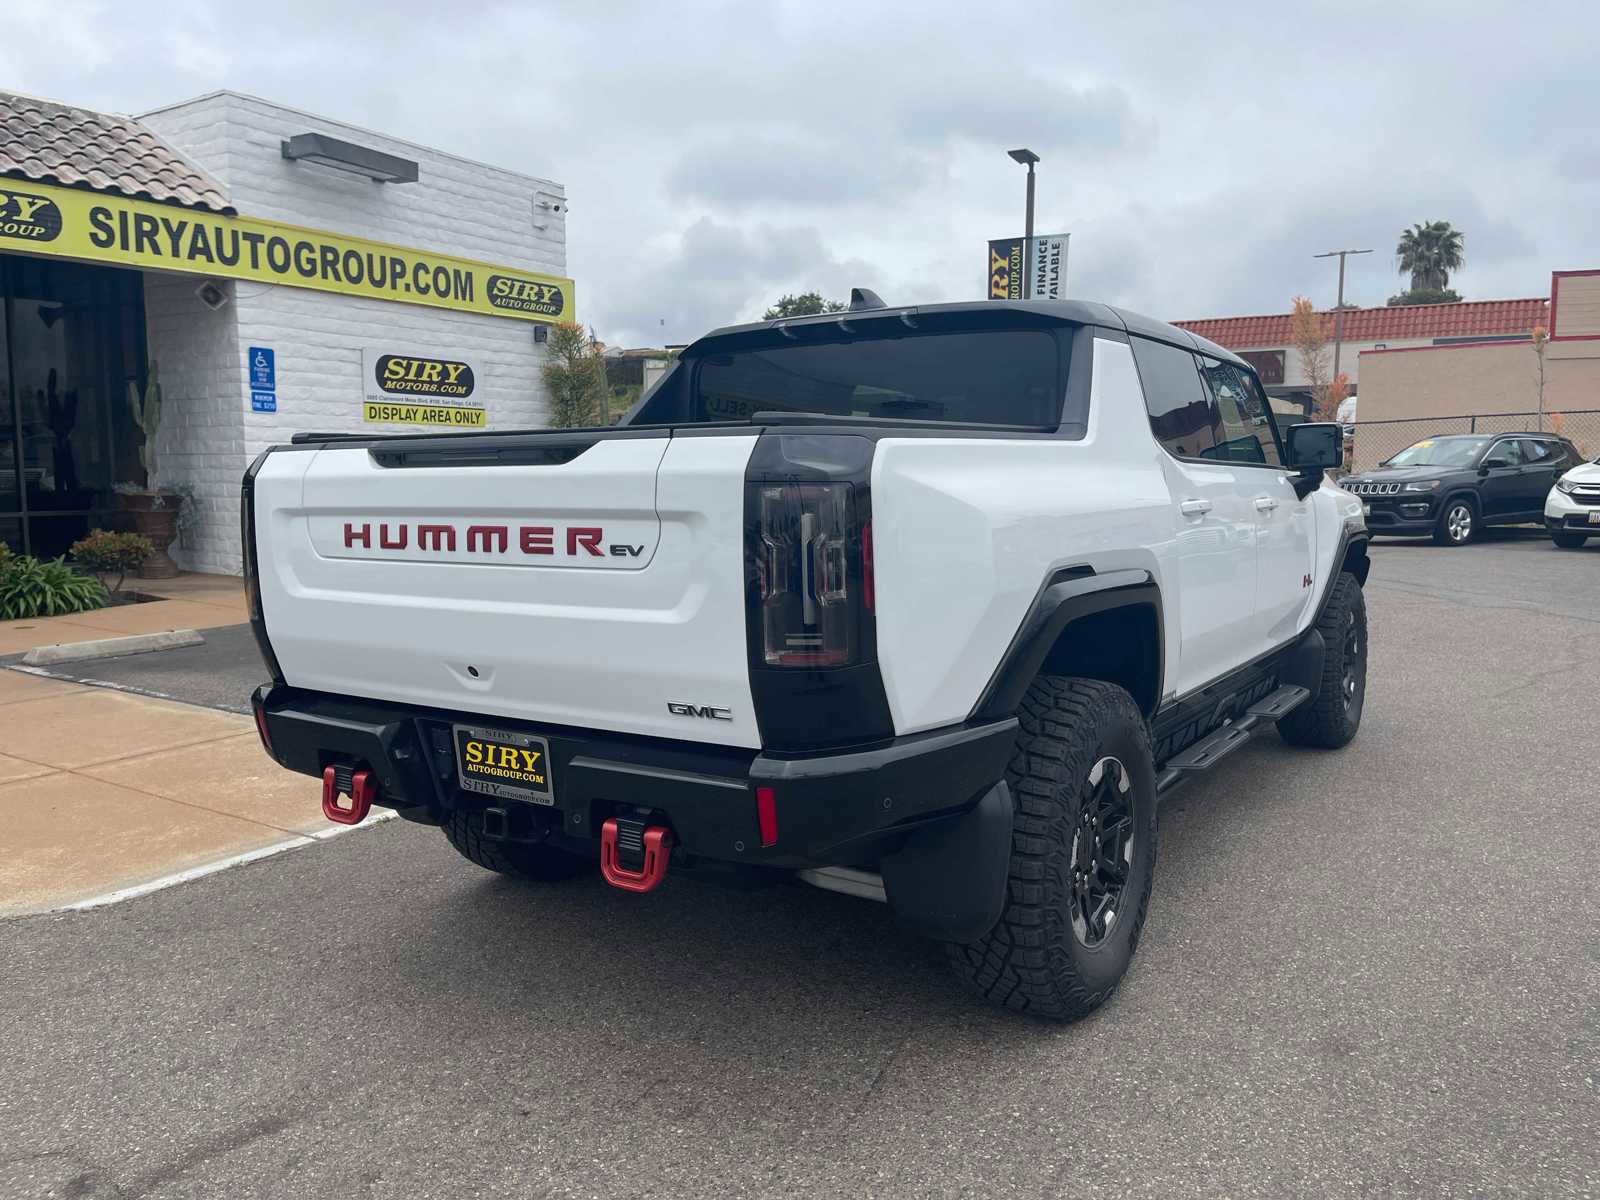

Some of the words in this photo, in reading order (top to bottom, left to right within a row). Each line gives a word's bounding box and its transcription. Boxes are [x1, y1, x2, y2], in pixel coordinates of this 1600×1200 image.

[0, 222, 46, 237] OUP
[89, 206, 474, 303] SIRYAUTOGROUP.COM
[1037, 239, 1048, 295] FINANCE
[492, 278, 558, 304] SIRY
[494, 297, 522, 309] AUTO
[522, 301, 556, 313] GROUP
[383, 358, 468, 384] SIRY
[384, 380, 467, 395] MOTORS.COM
[368, 406, 419, 422] DISPLAY
[421, 408, 452, 424] AREA
[454, 410, 481, 425] ONLY
[343, 523, 606, 557] HUMMER
[609, 544, 645, 557] EV
[667, 701, 733, 722] GMC
[465, 741, 541, 772] SIRY
[467, 763, 544, 784] AUTOGROUP.COM
[463, 779, 501, 795] SIRY
